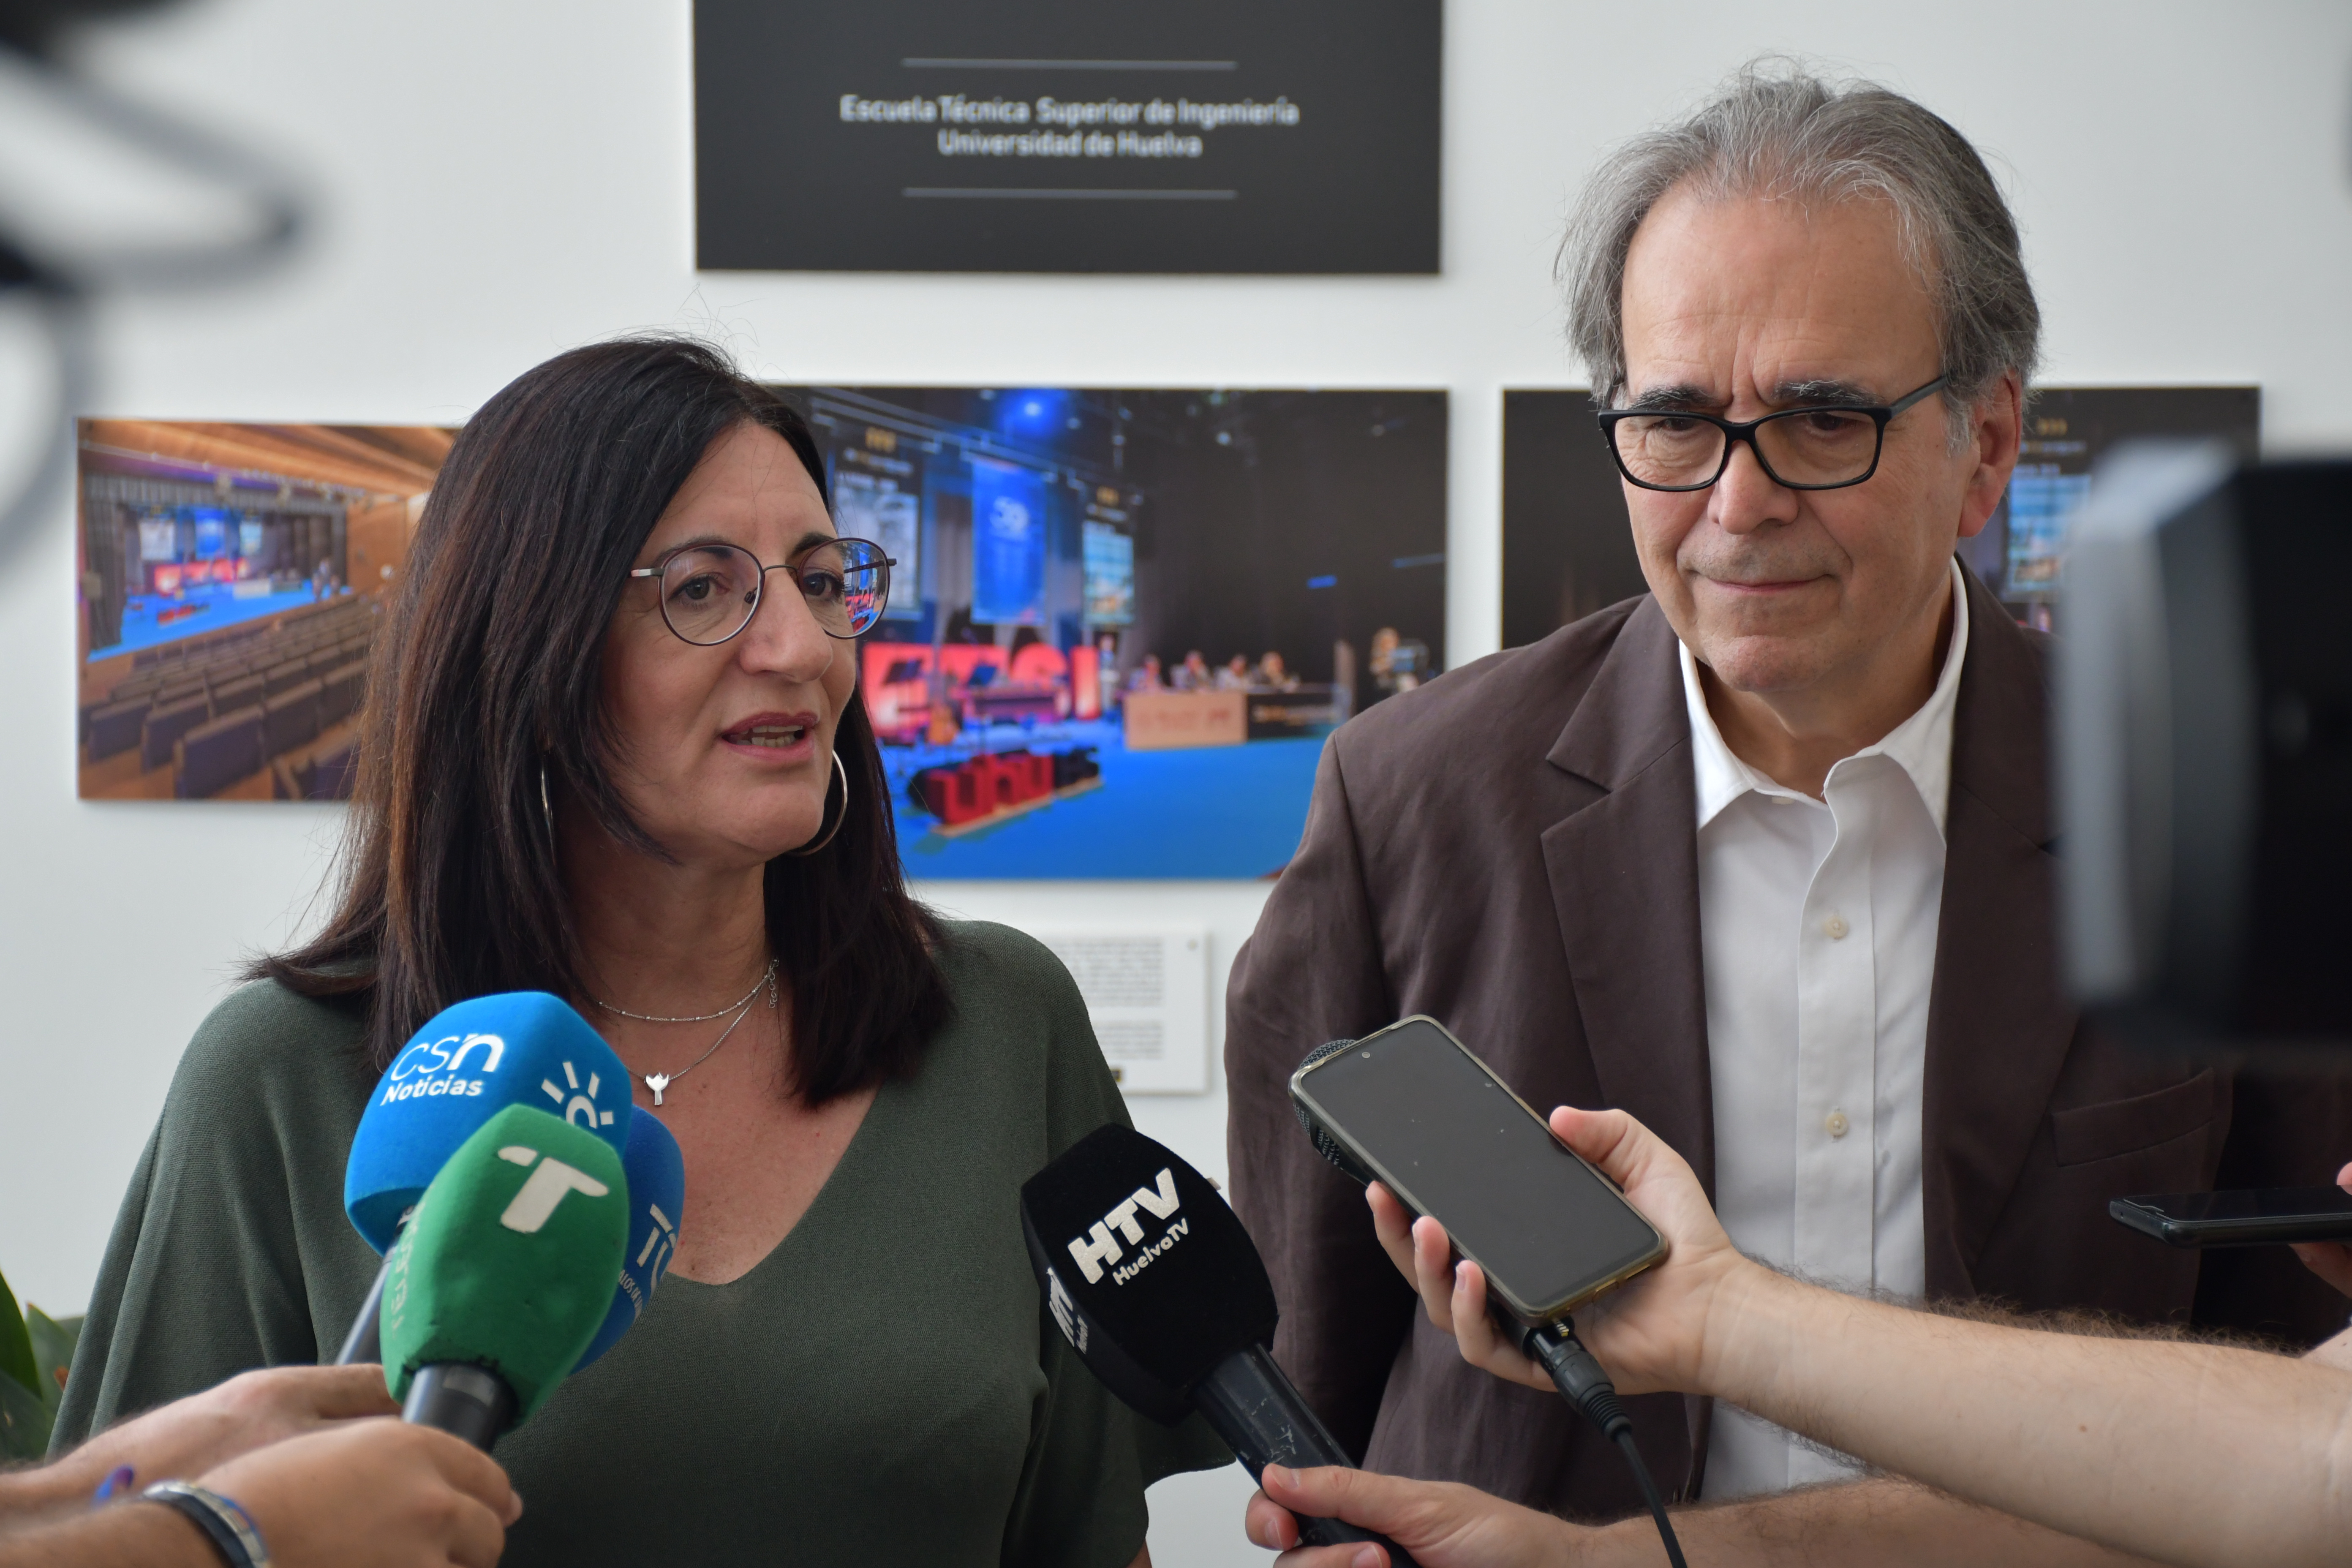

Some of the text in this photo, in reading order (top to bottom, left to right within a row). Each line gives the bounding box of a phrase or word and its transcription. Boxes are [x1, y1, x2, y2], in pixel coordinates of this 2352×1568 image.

[840, 93, 1300, 130] Escuela Técnica Superior de Ingeniería
[938, 128, 1203, 158] Universidad de Huelva
[379, 1073, 484, 1106] Noticias
[1067, 1168, 1180, 1285] HTV
